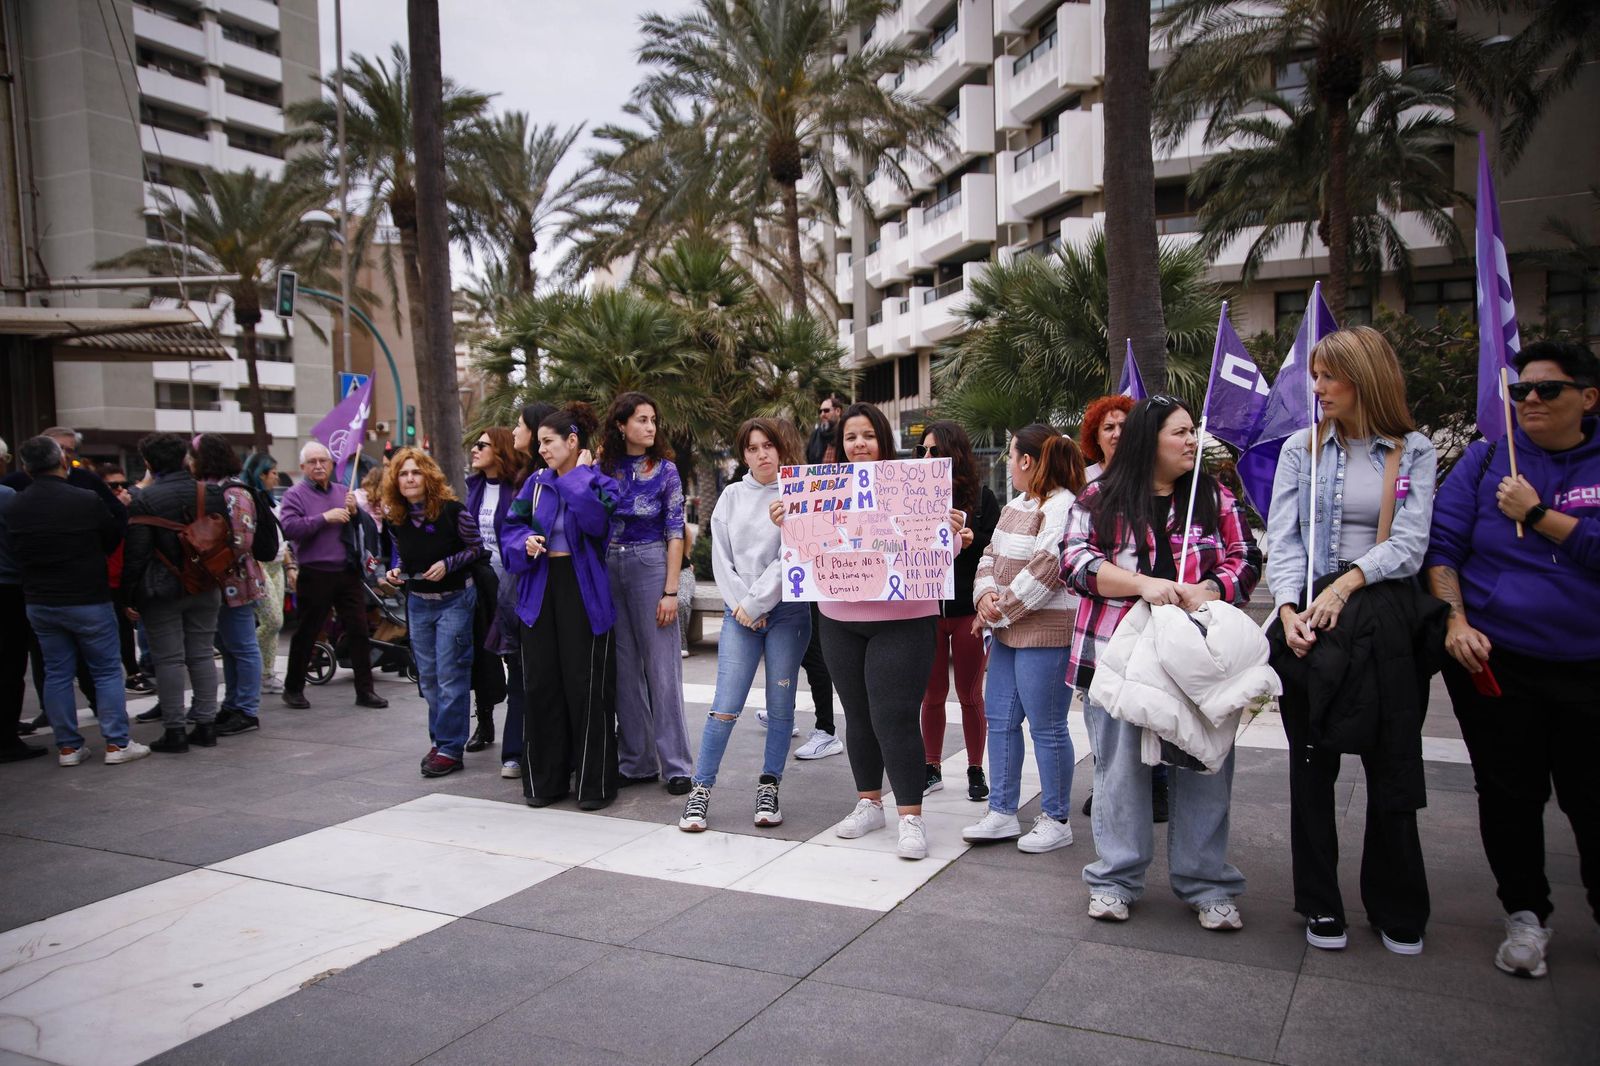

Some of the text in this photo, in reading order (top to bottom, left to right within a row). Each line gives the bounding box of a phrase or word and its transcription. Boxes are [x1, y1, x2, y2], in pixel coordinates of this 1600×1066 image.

[875, 461, 895, 480] NO
[783, 477, 848, 495] QUE NADIE
[788, 497, 852, 514] ME CUIDE
[783, 518, 805, 546] NO
[798, 542, 820, 560] NO
[816, 550, 824, 568] El
[906, 568, 944, 580] ERA UNA
[904, 582, 945, 599] MUJER
